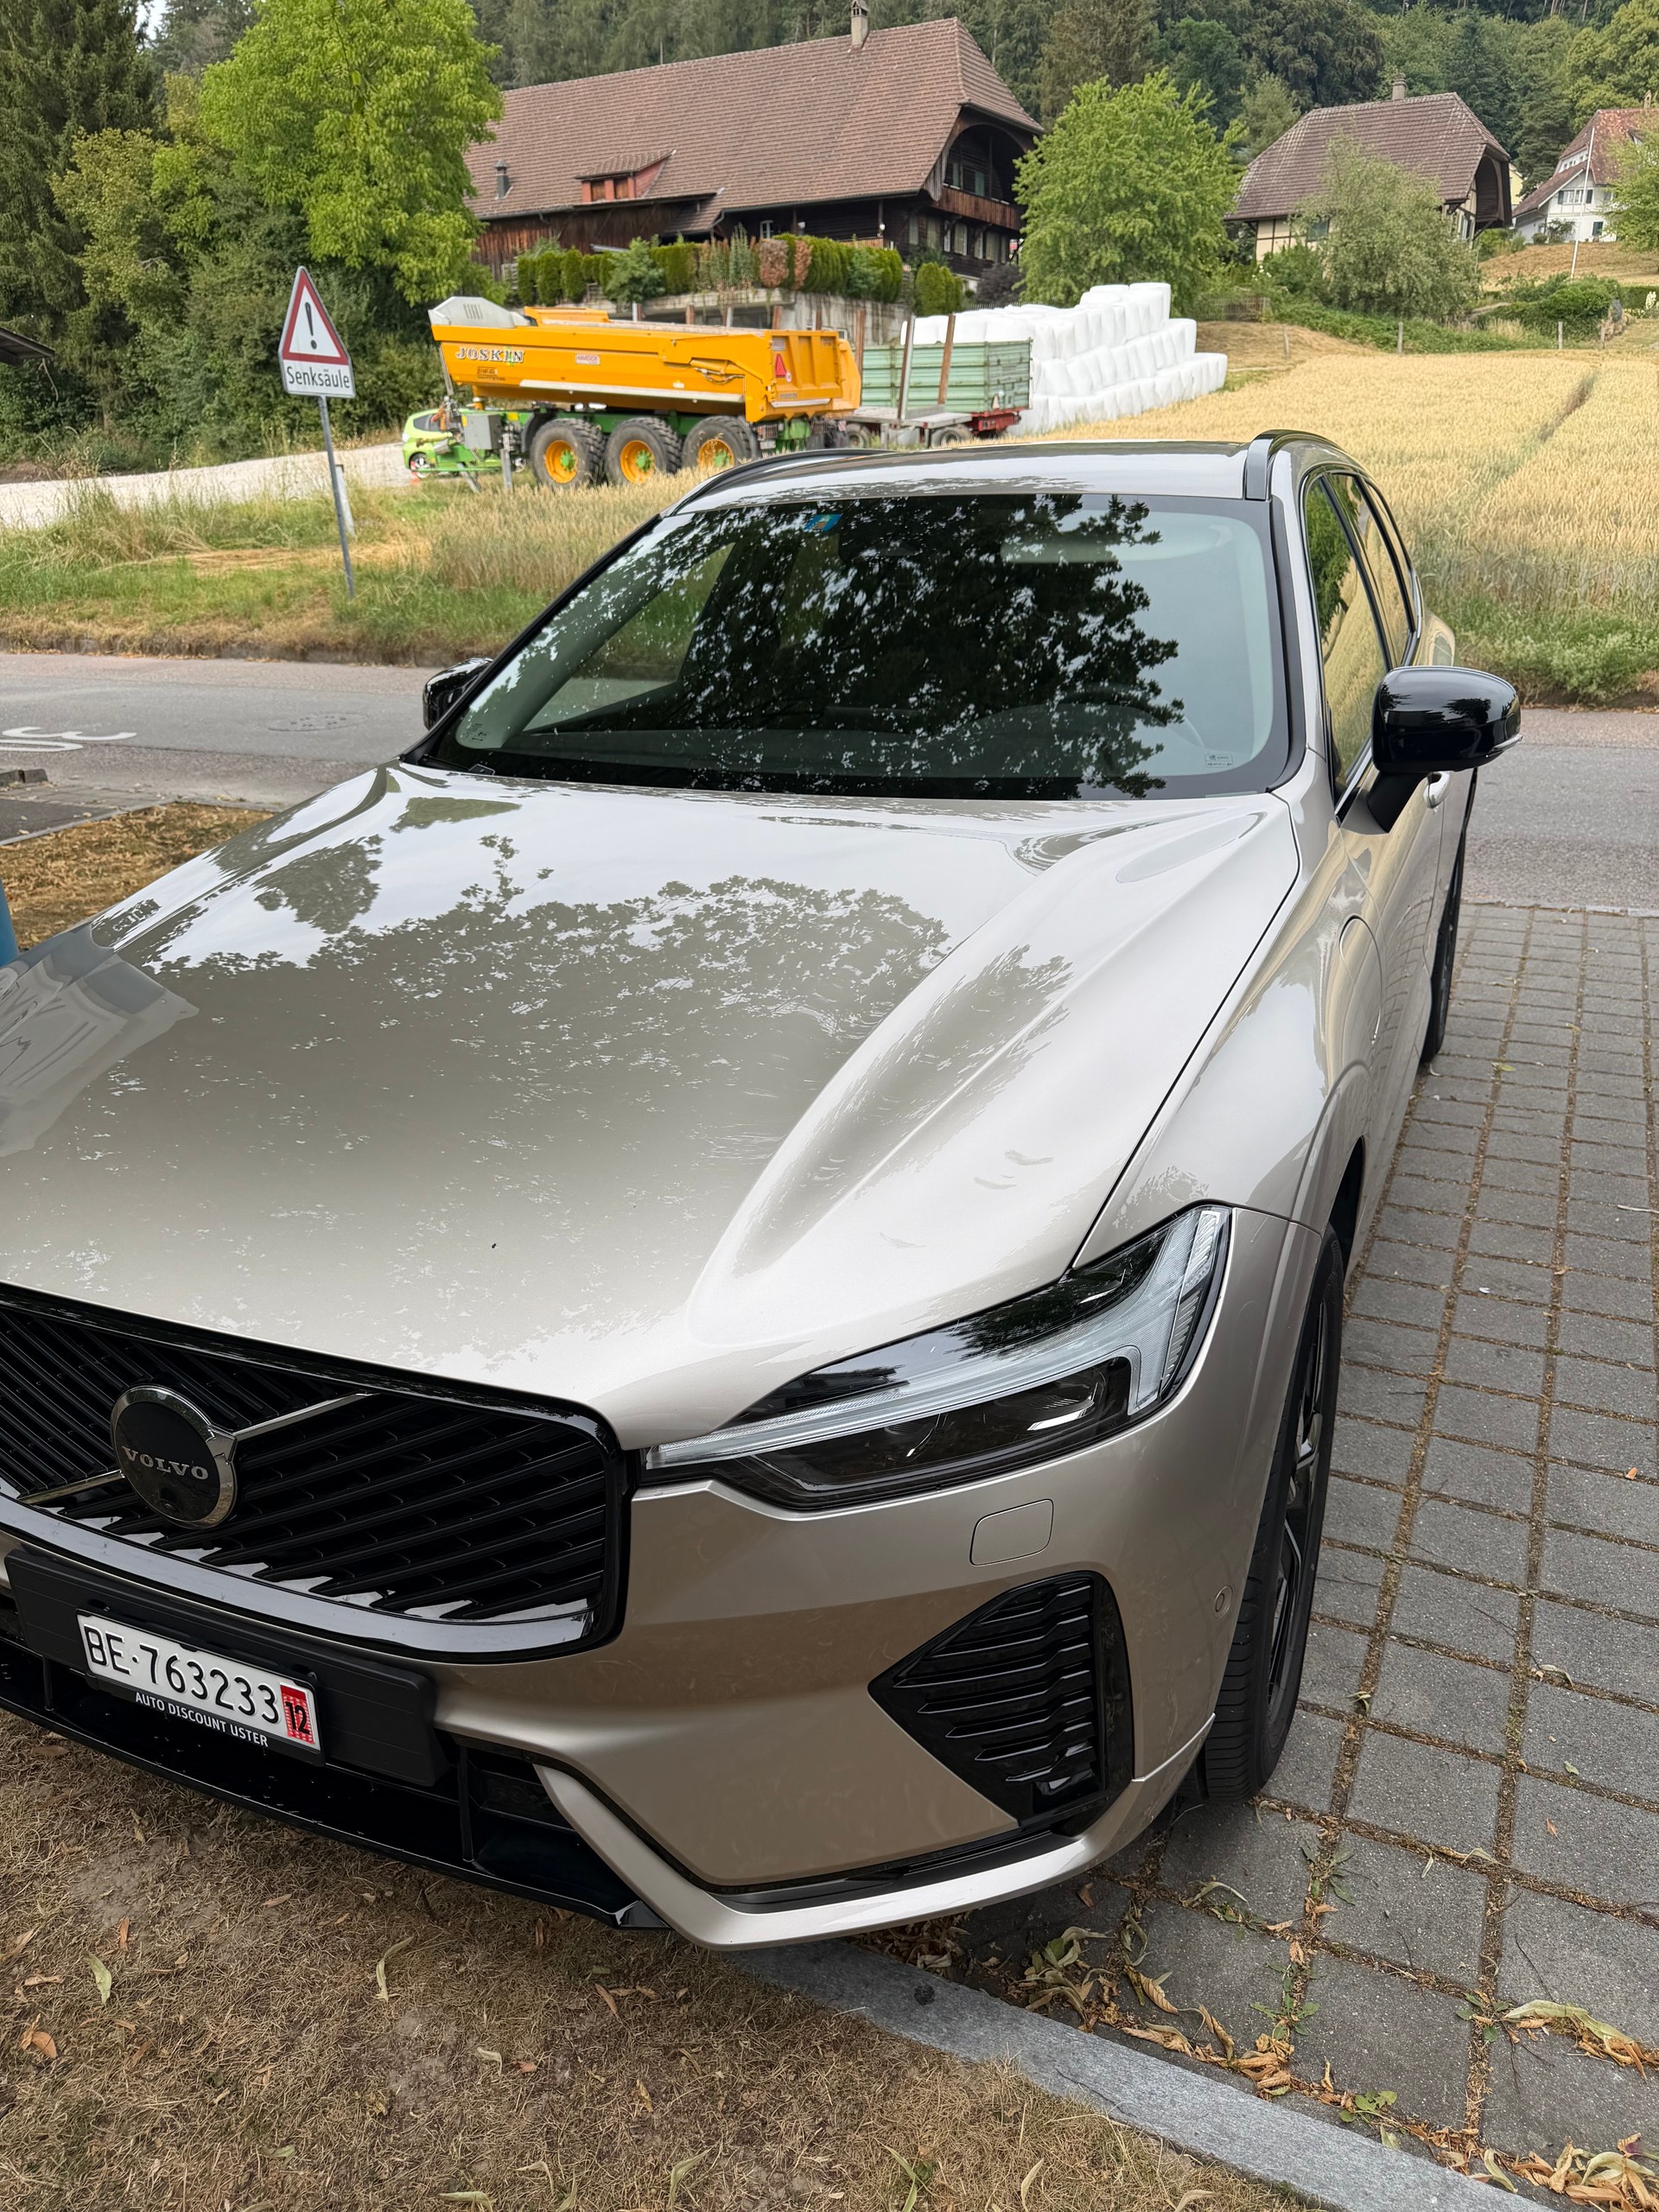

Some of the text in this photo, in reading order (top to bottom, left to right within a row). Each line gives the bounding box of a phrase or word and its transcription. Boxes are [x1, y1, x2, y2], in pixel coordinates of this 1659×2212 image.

[455, 346, 524, 363] JOSKIN
[287, 366, 350, 388] Senksäule
[122, 1446, 209, 1480] VOLVO
[135, 1691, 269, 1747] AUTO DISCOUNT USTER
[285, 1700, 310, 1735] 12
